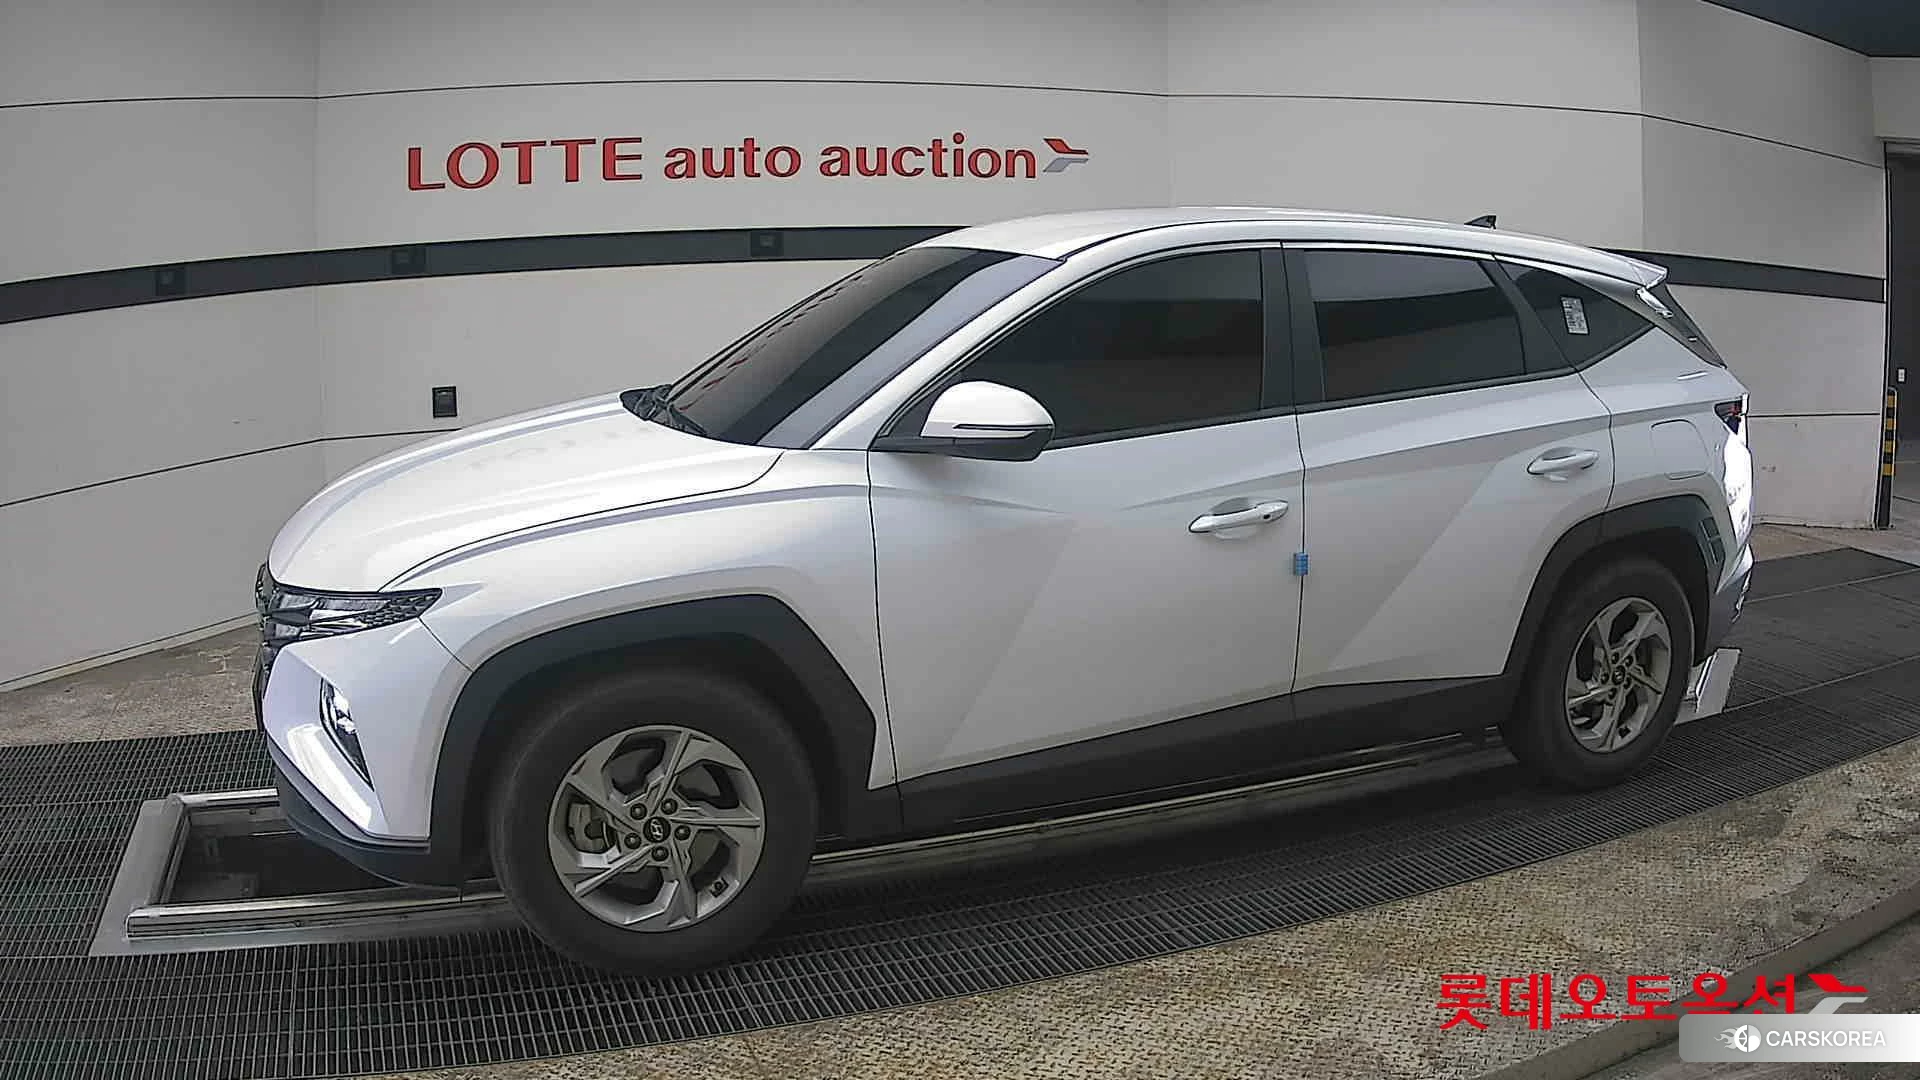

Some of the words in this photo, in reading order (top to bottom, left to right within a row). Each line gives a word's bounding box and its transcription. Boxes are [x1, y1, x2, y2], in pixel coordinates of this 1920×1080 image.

[407, 137, 643, 191] LOTTE
[663, 137, 801, 179] auto
[818, 132, 1038, 178] auction
